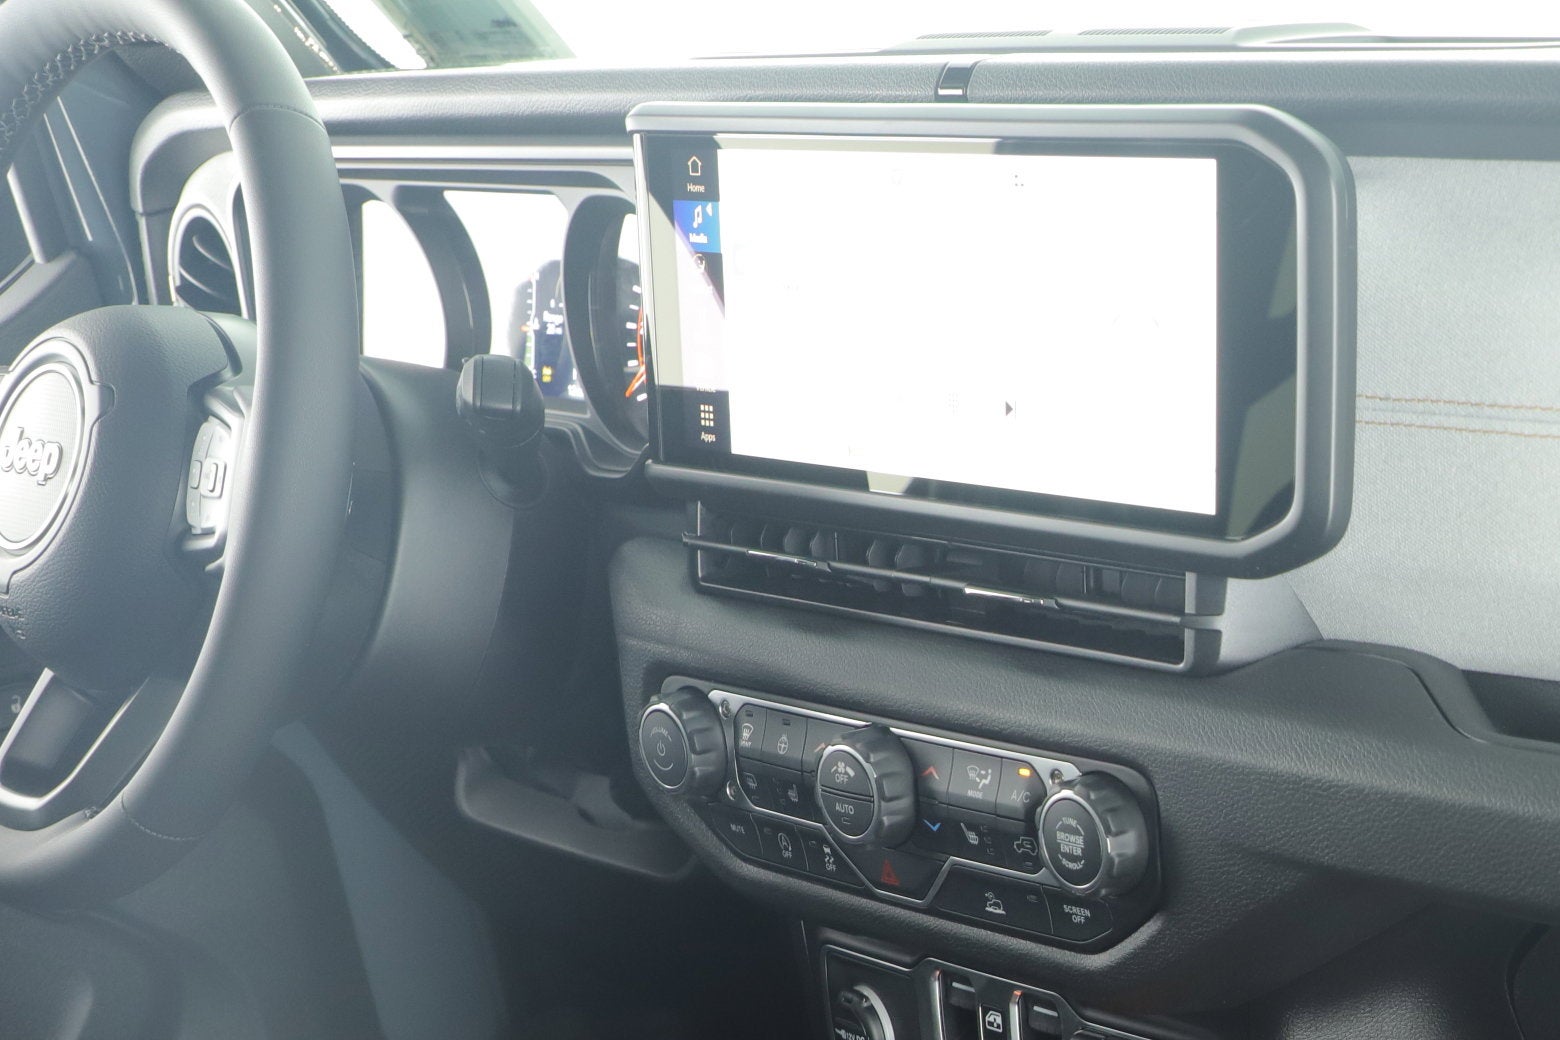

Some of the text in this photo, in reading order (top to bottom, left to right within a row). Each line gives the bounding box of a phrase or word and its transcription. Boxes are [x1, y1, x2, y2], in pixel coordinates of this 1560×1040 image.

[687, 183, 705, 193] Home
[700, 431, 716, 444] Apps
[1, 426, 64, 487] Jeep
[834, 773, 849, 785] OFF
[966, 789, 984, 800] MODE
[1010, 790, 1031, 803] A/C
[835, 801, 855, 815] AUTO
[1062, 817, 1078, 828] TUNE
[730, 823, 746, 835] MUTE
[1056, 830, 1084, 845] BROWSE
[782, 850, 793, 860] OFF
[1060, 843, 1082, 856] ENTER
[825, 863, 837, 873] OFF
[1061, 858, 1083, 870] SCROLL
[1063, 904, 1091, 918] SCREEN
[1072, 915, 1086, 925] OFF
